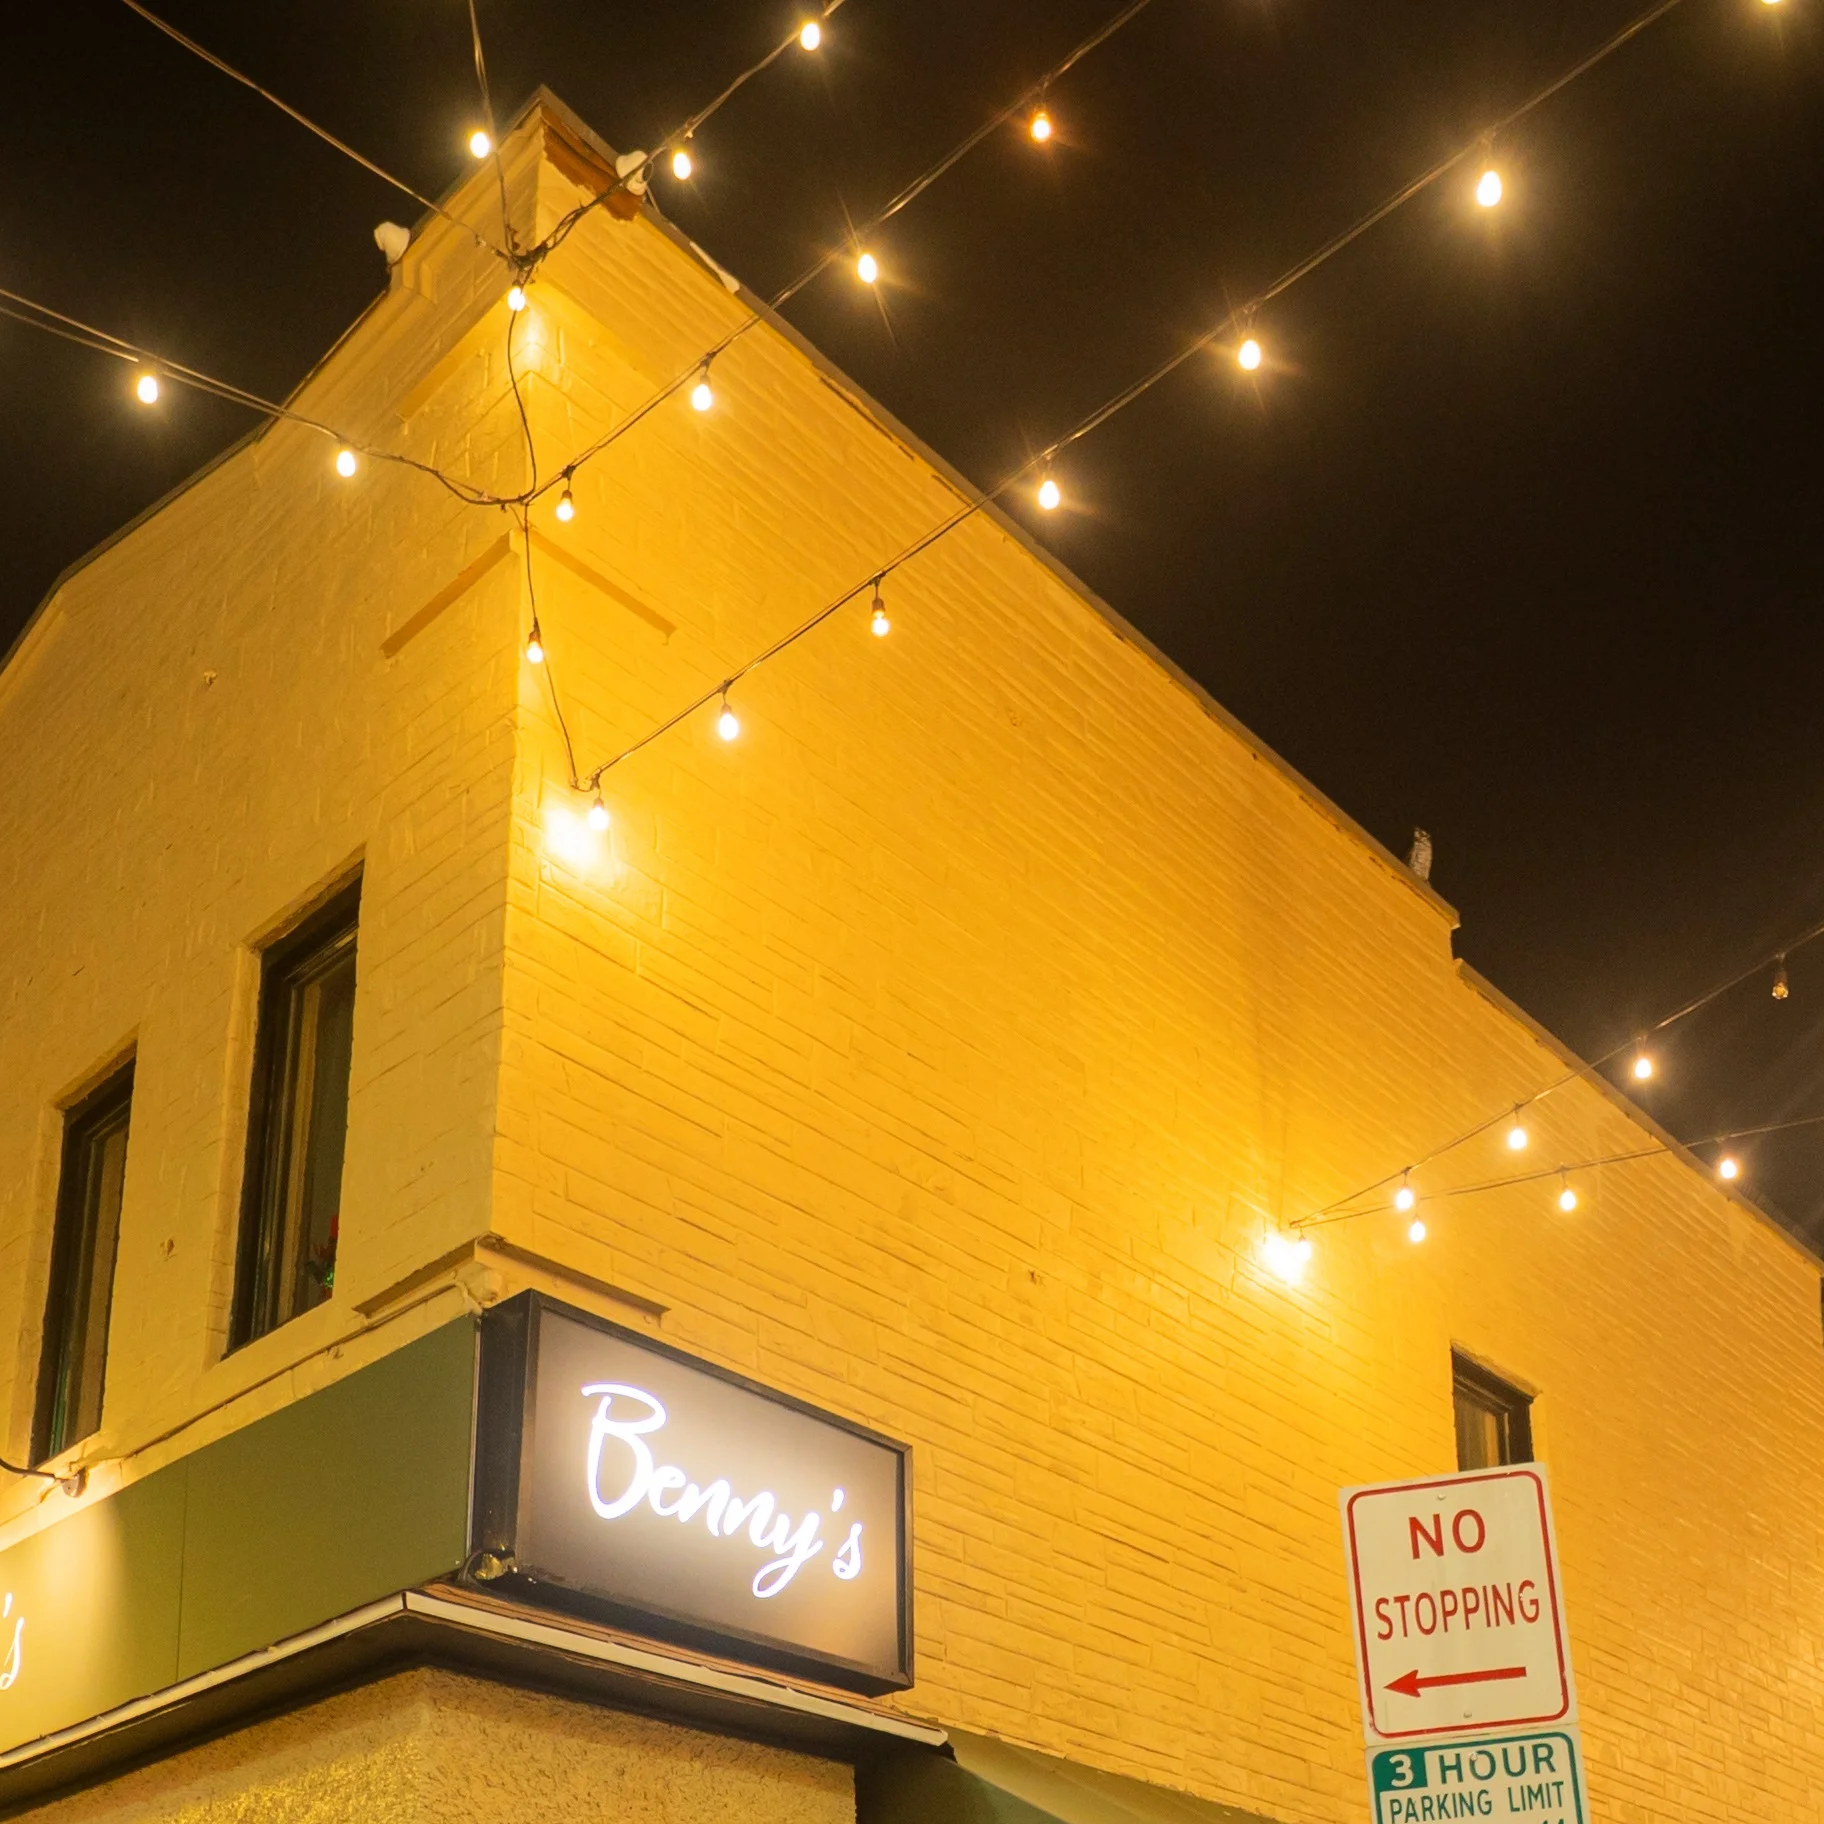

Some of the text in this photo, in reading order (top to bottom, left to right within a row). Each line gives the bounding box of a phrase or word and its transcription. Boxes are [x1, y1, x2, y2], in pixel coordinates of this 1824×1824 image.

[581, 1383, 863, 1598] Benny's
[1409, 1509, 1485, 1560] NO
[1375, 1580, 1540, 1640] STOPPING
[1389, 1743, 1556, 1788] 3 HOUR
[1389, 1781, 1564, 1824] PARKING LIMIT
